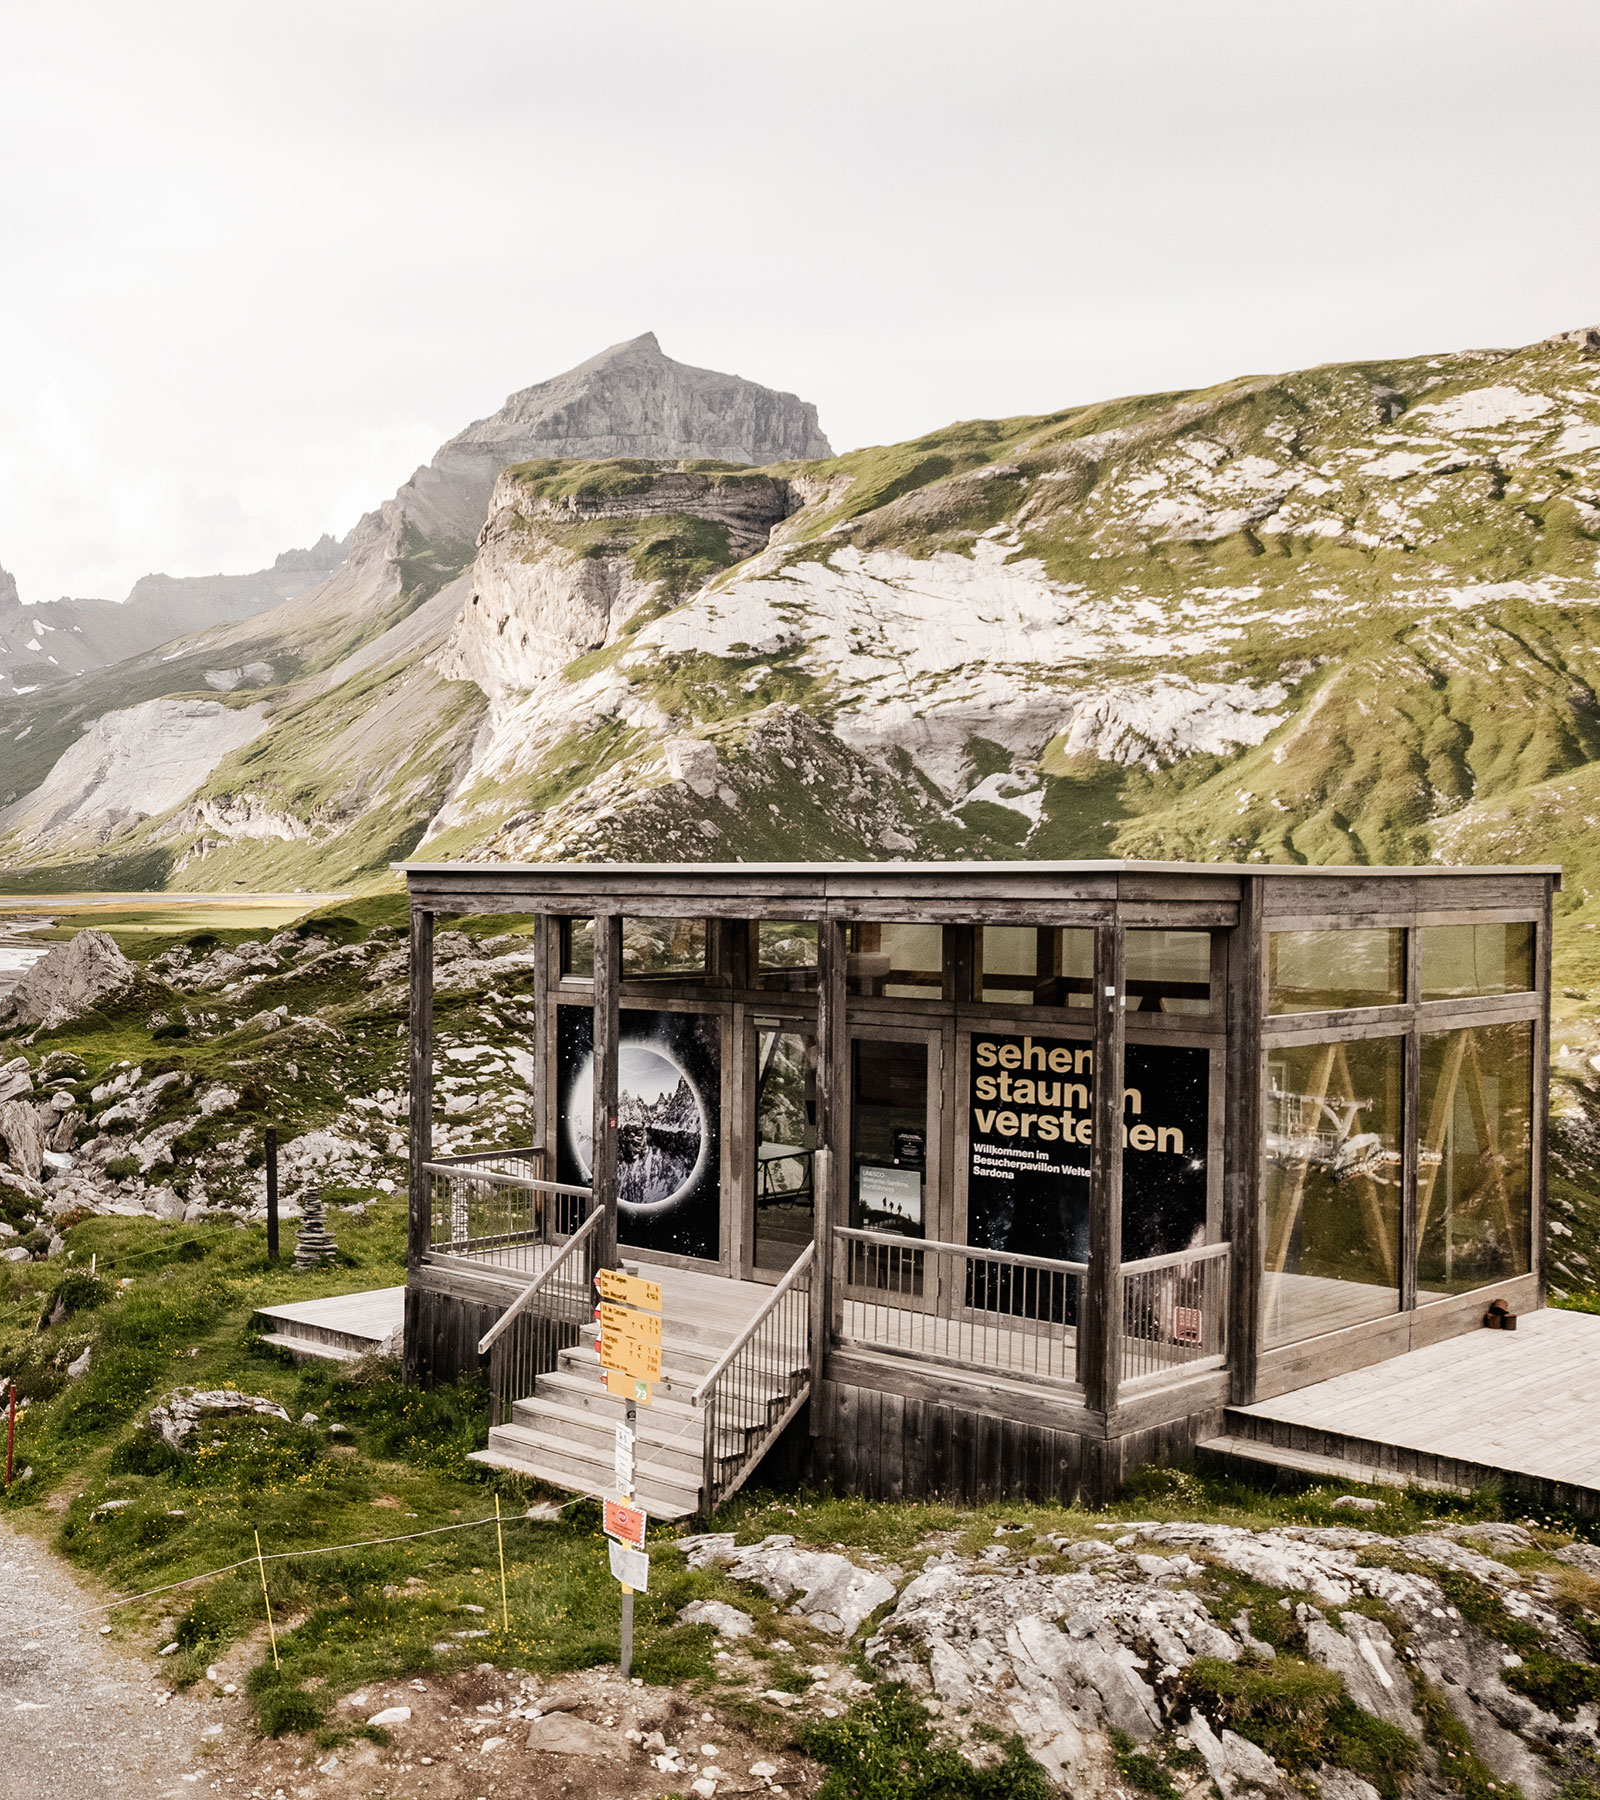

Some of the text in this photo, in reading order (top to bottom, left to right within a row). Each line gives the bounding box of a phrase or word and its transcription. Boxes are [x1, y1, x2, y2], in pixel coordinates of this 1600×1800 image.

[976, 1037, 1092, 1074] sehen
[975, 1071, 1142, 1114] staunn
[974, 1108, 1184, 1154] versteen
[973, 1143, 1049, 1160] Willkommen im
[973, 1154, 1092, 1178] Besucherpavillon Welte
[973, 1166, 1015, 1180] Sardona
